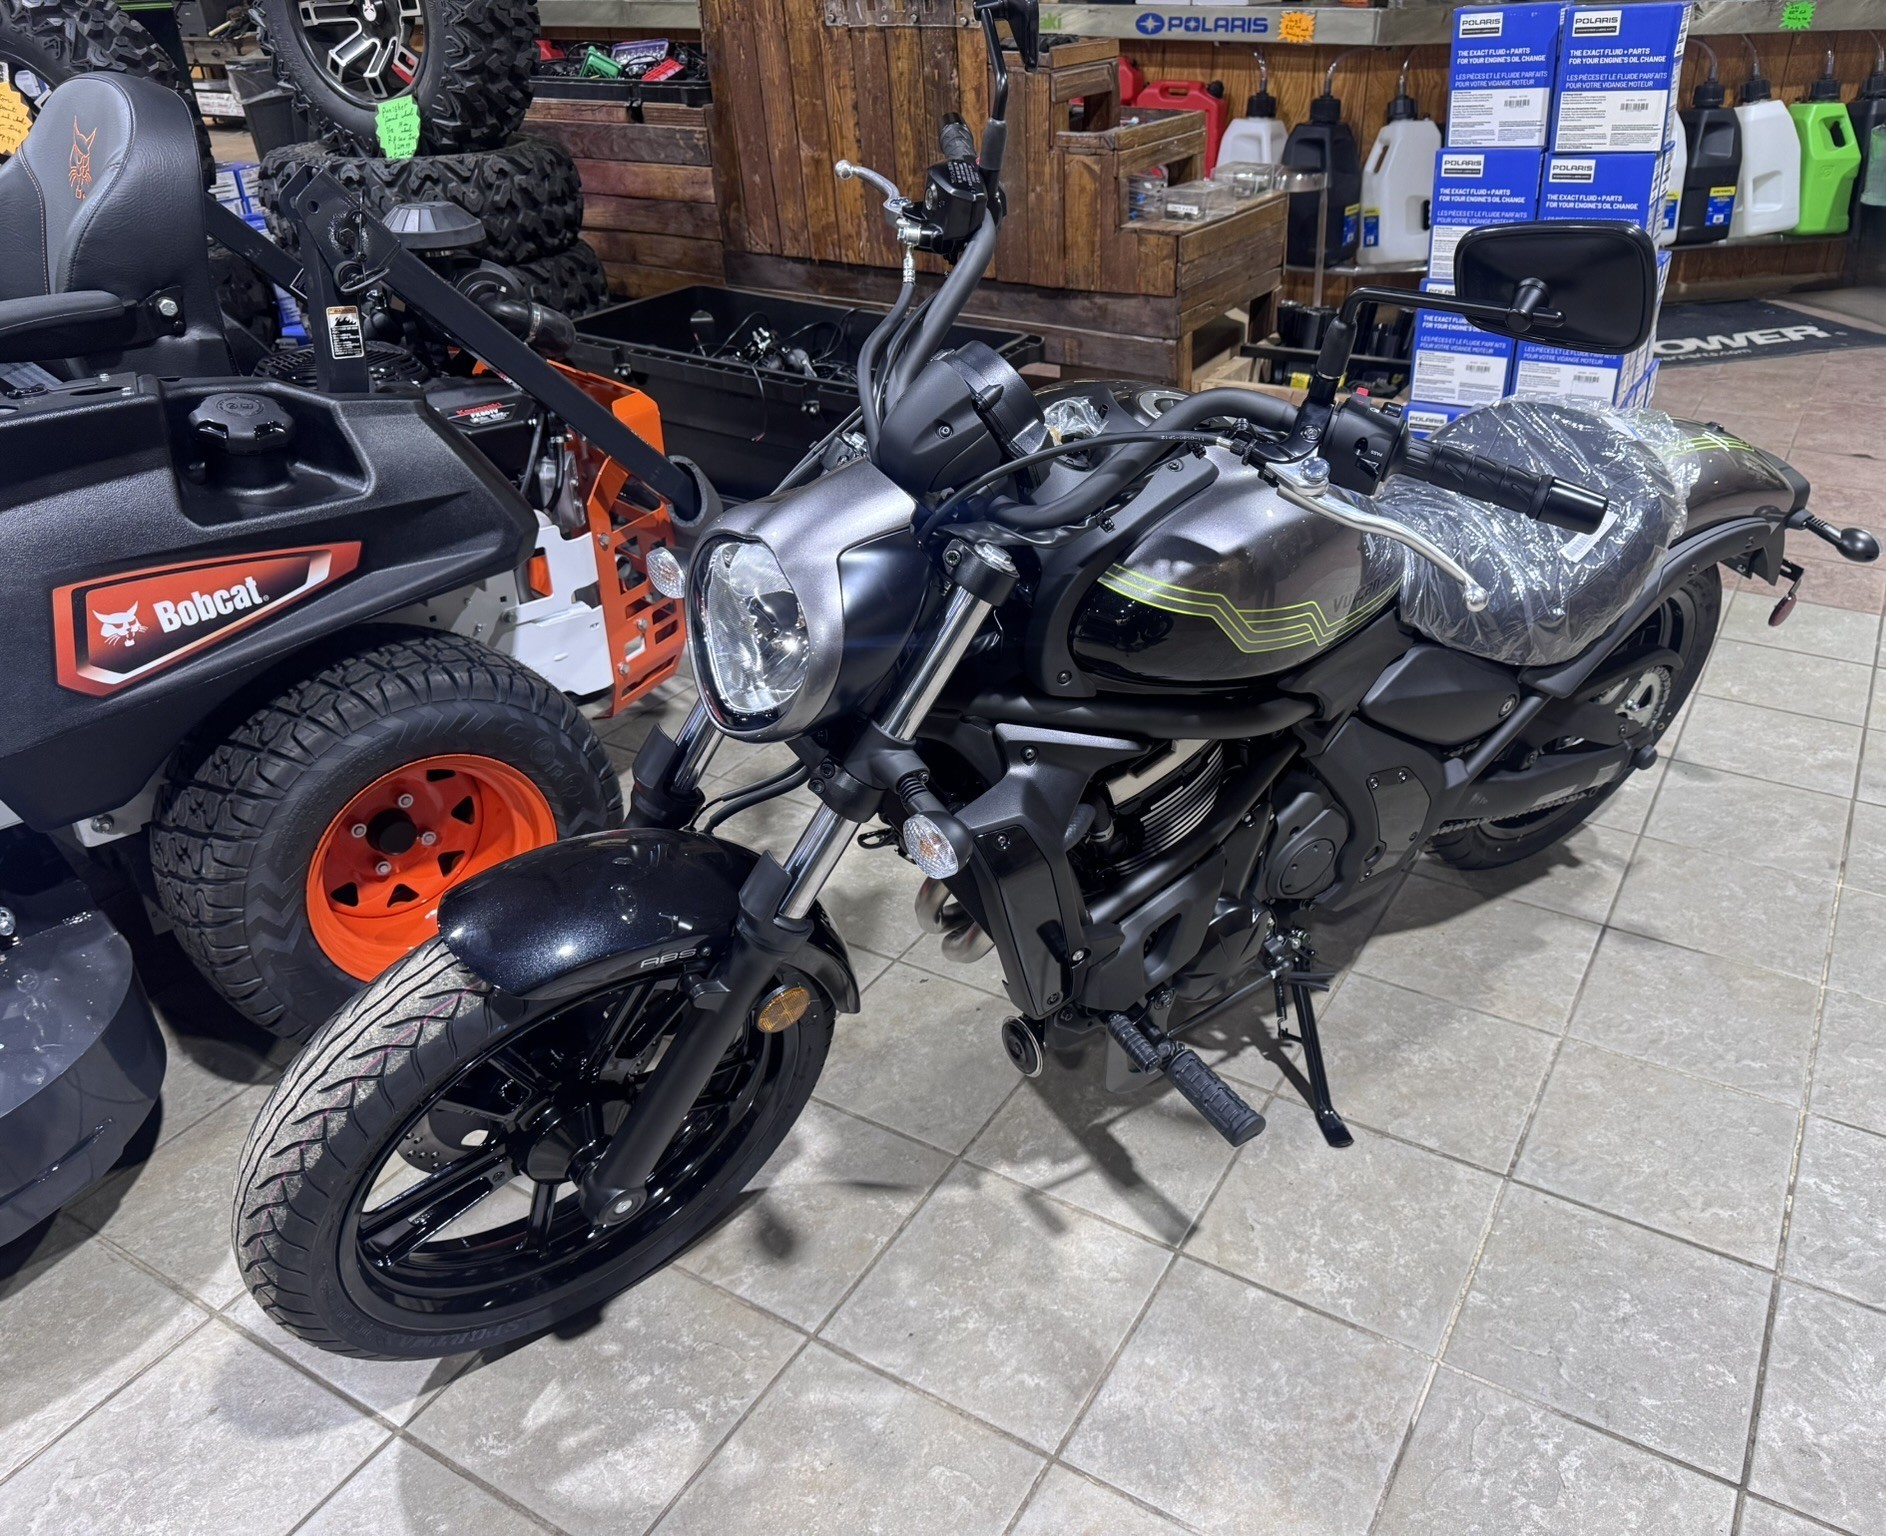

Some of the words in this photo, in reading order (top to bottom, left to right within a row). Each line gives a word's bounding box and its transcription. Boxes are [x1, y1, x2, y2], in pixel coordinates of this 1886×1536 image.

[1168, 16, 1268, 33] POLARIS
[1600, 56, 1628, 64] ENGINE'S
[1653, 325, 1831, 354] OWER
[1410, 416, 1444, 424] POLARIS
[153, 576, 263, 633] Bobcat
[640, 948, 697, 968] ABS
